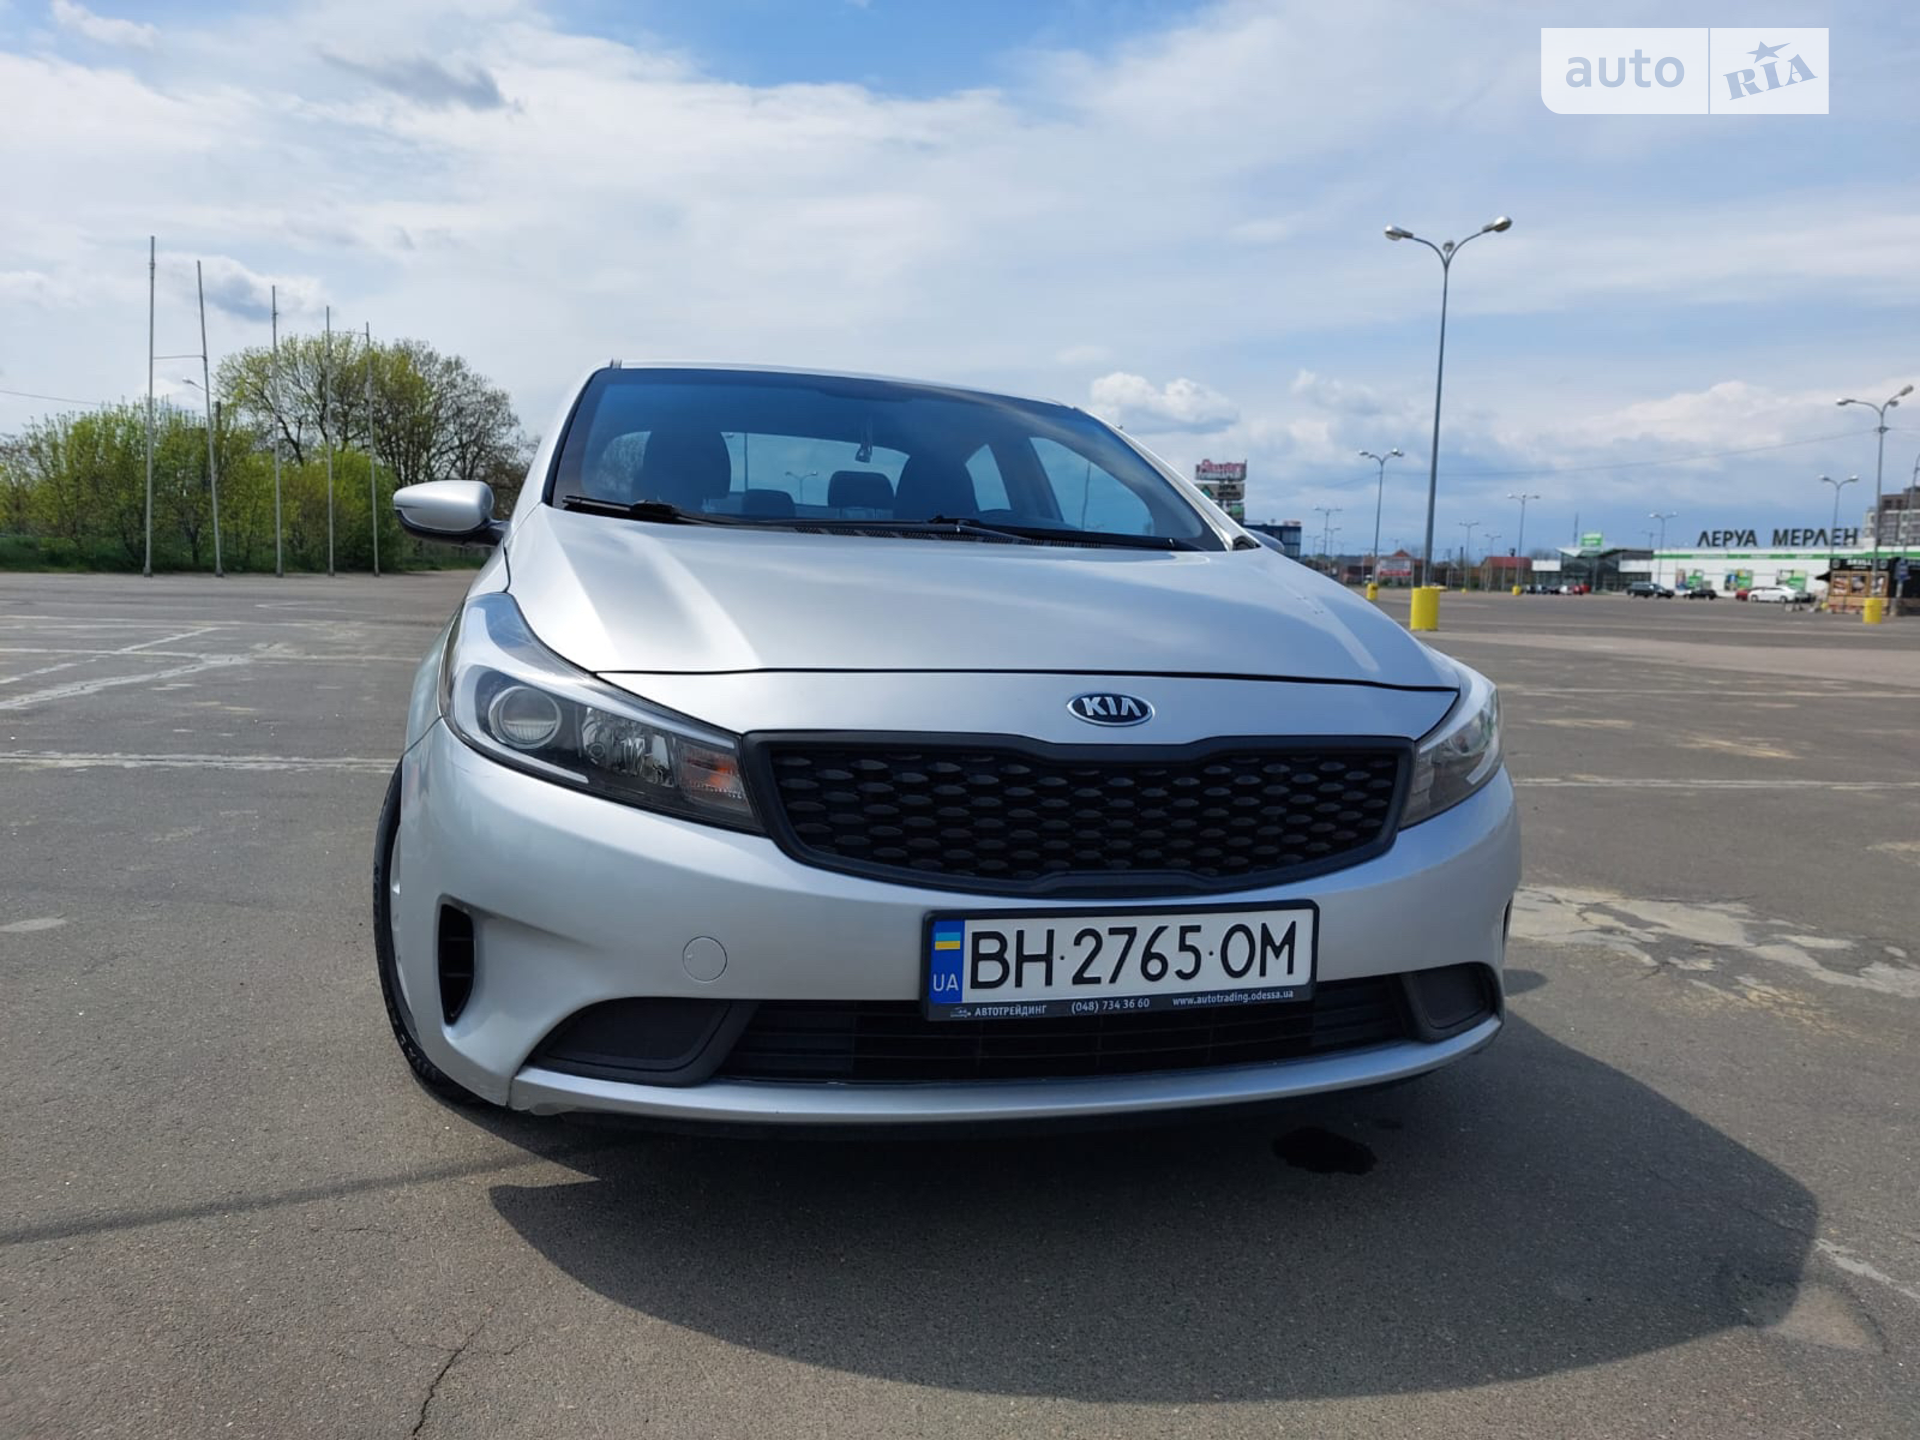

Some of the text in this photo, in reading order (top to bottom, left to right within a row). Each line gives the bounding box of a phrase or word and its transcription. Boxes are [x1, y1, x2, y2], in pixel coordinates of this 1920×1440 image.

[1697, 527, 1858, 548] ЛЕРУА МЕРЛЕН
[1080, 696, 1142, 717] KIA
[932, 973, 960, 993] UA
[1071, 998, 1151, 1015] (048) 734 36 60
[1172, 989, 1294, 1006] www.autotrading.odessa.ua
[974, 1004, 1047, 1017] АВТОТРЕЙДИНГ
